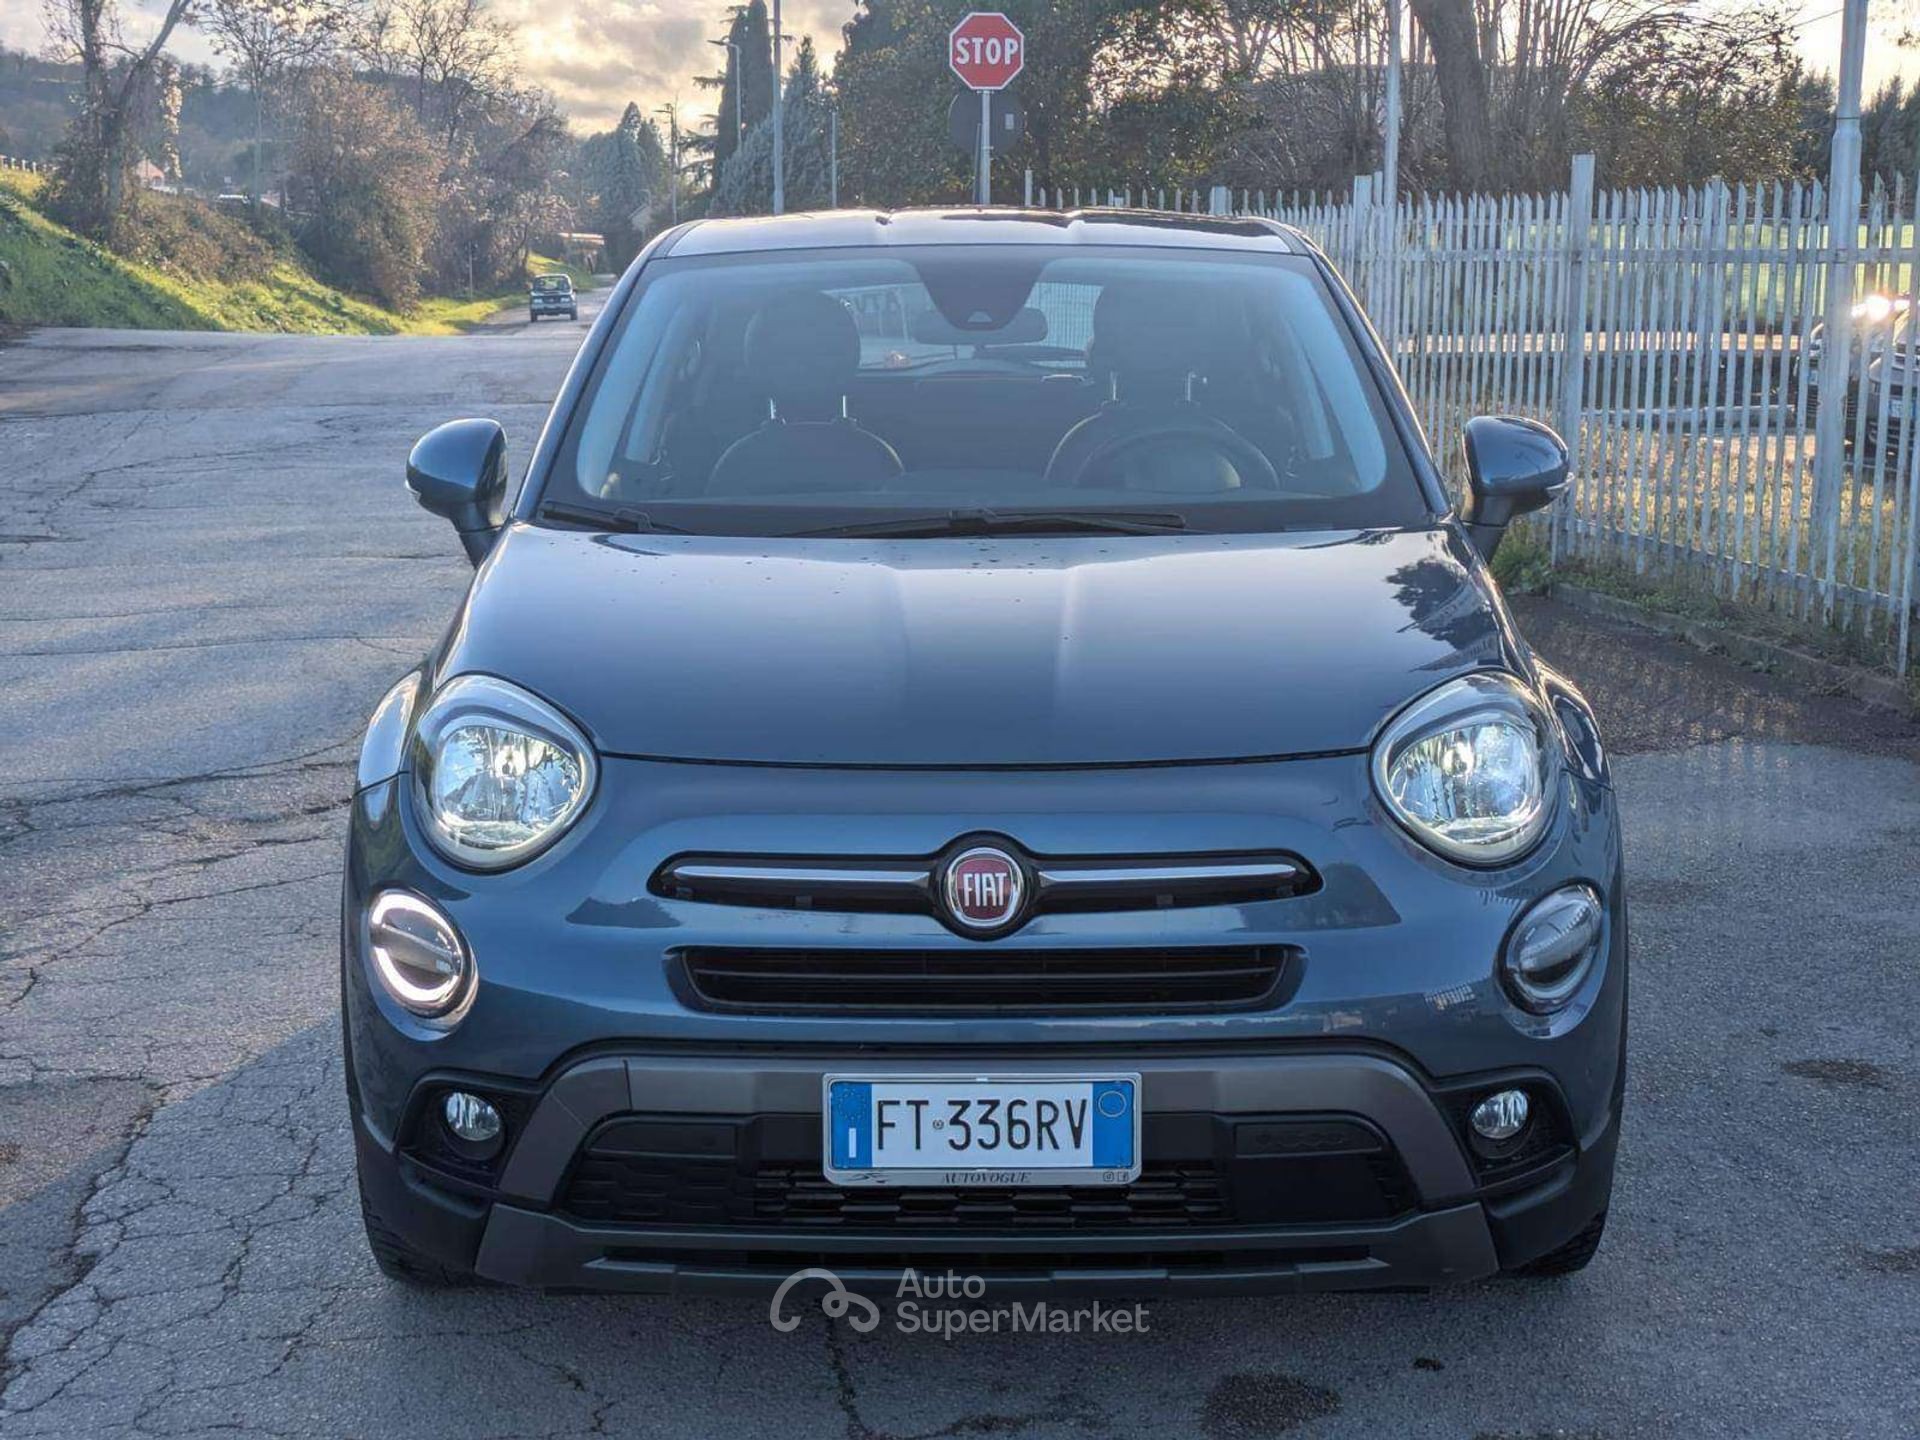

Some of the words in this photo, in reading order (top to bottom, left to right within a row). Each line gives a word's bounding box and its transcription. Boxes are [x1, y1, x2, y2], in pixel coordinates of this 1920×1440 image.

[956, 36, 1019, 66] STOP
[962, 872, 1007, 907] FIAT
[942, 1171, 1032, 1184] AUTOVOGUE
